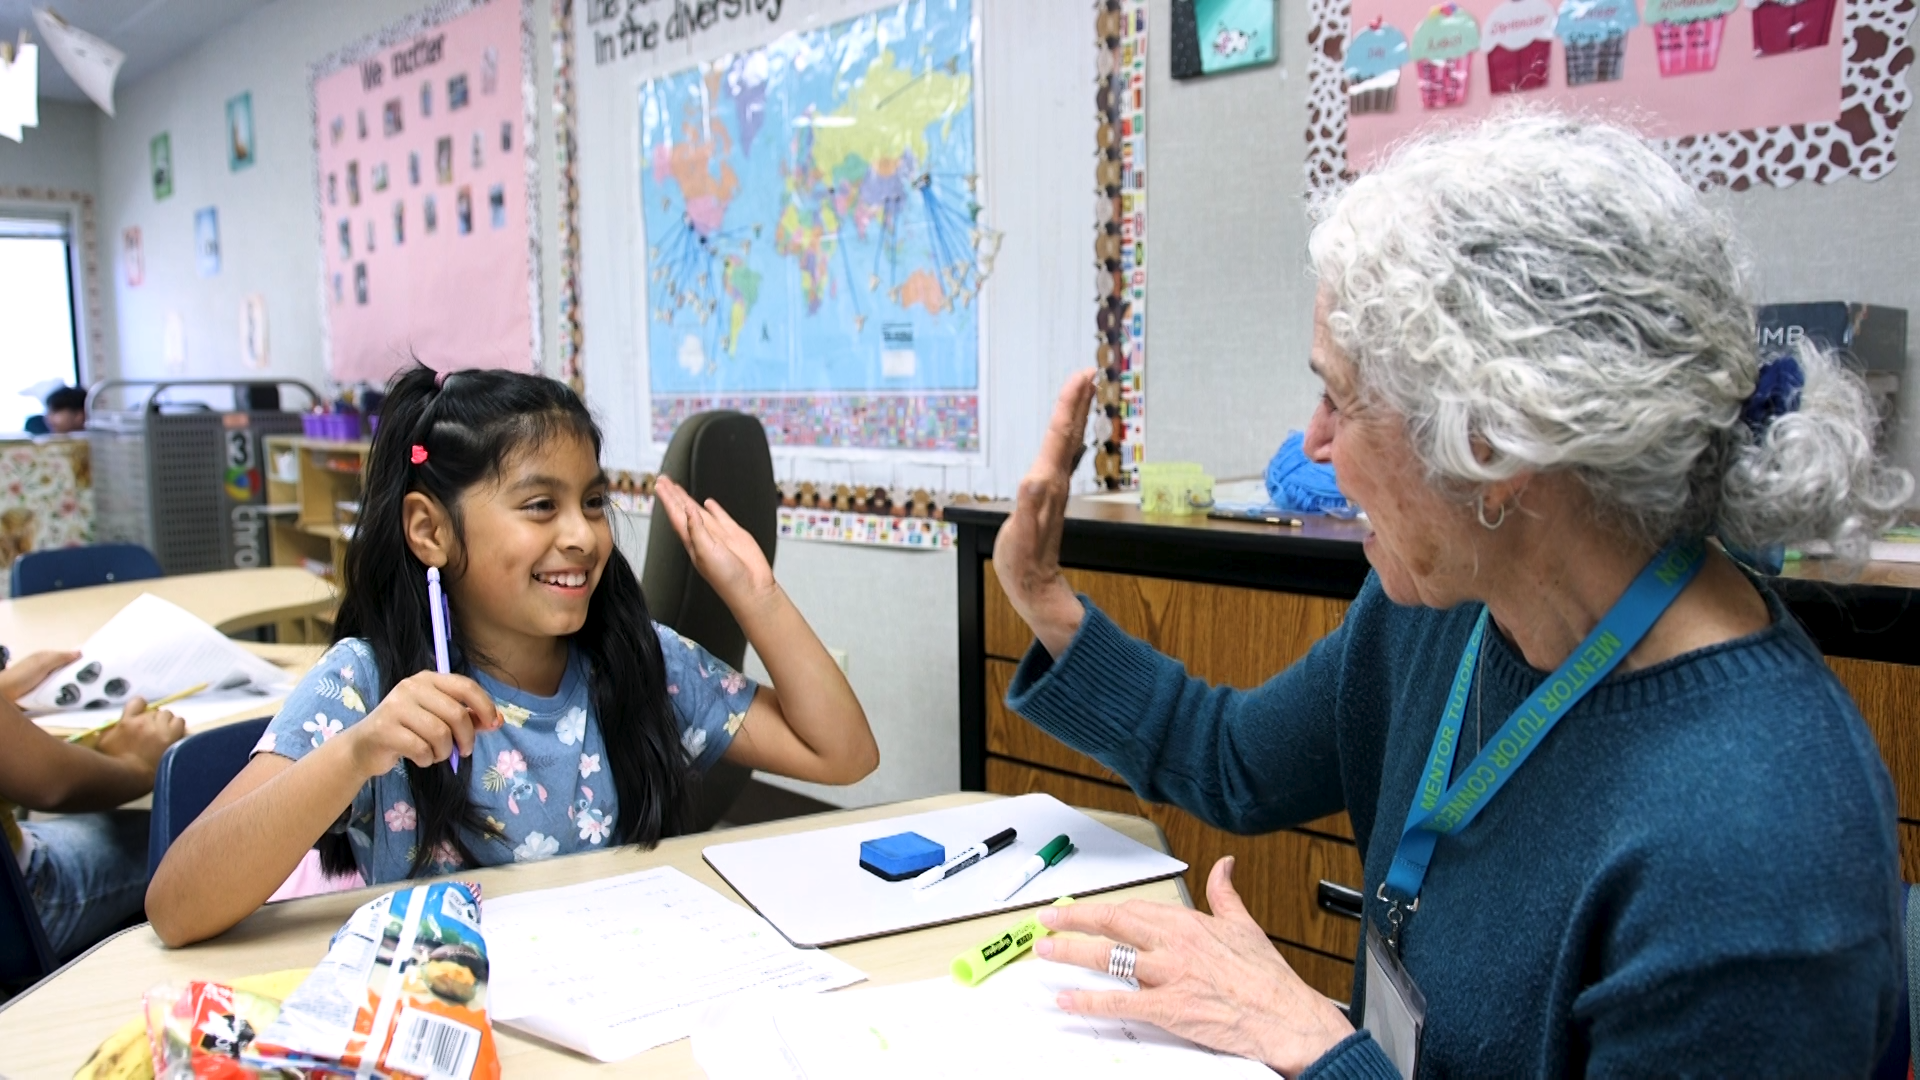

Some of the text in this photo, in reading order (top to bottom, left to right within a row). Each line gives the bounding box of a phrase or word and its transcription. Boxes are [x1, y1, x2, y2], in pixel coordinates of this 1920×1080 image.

[361, 33, 444, 90] We matter
[1755, 325, 1805, 346] MB
[231, 433, 248, 466] 3
[1539, 630, 1622, 713] MENTOR
[1420, 725, 1455, 811] MENTOR
[1447, 652, 1474, 720] TUTOR
[1489, 708, 1546, 768] TUTOR
